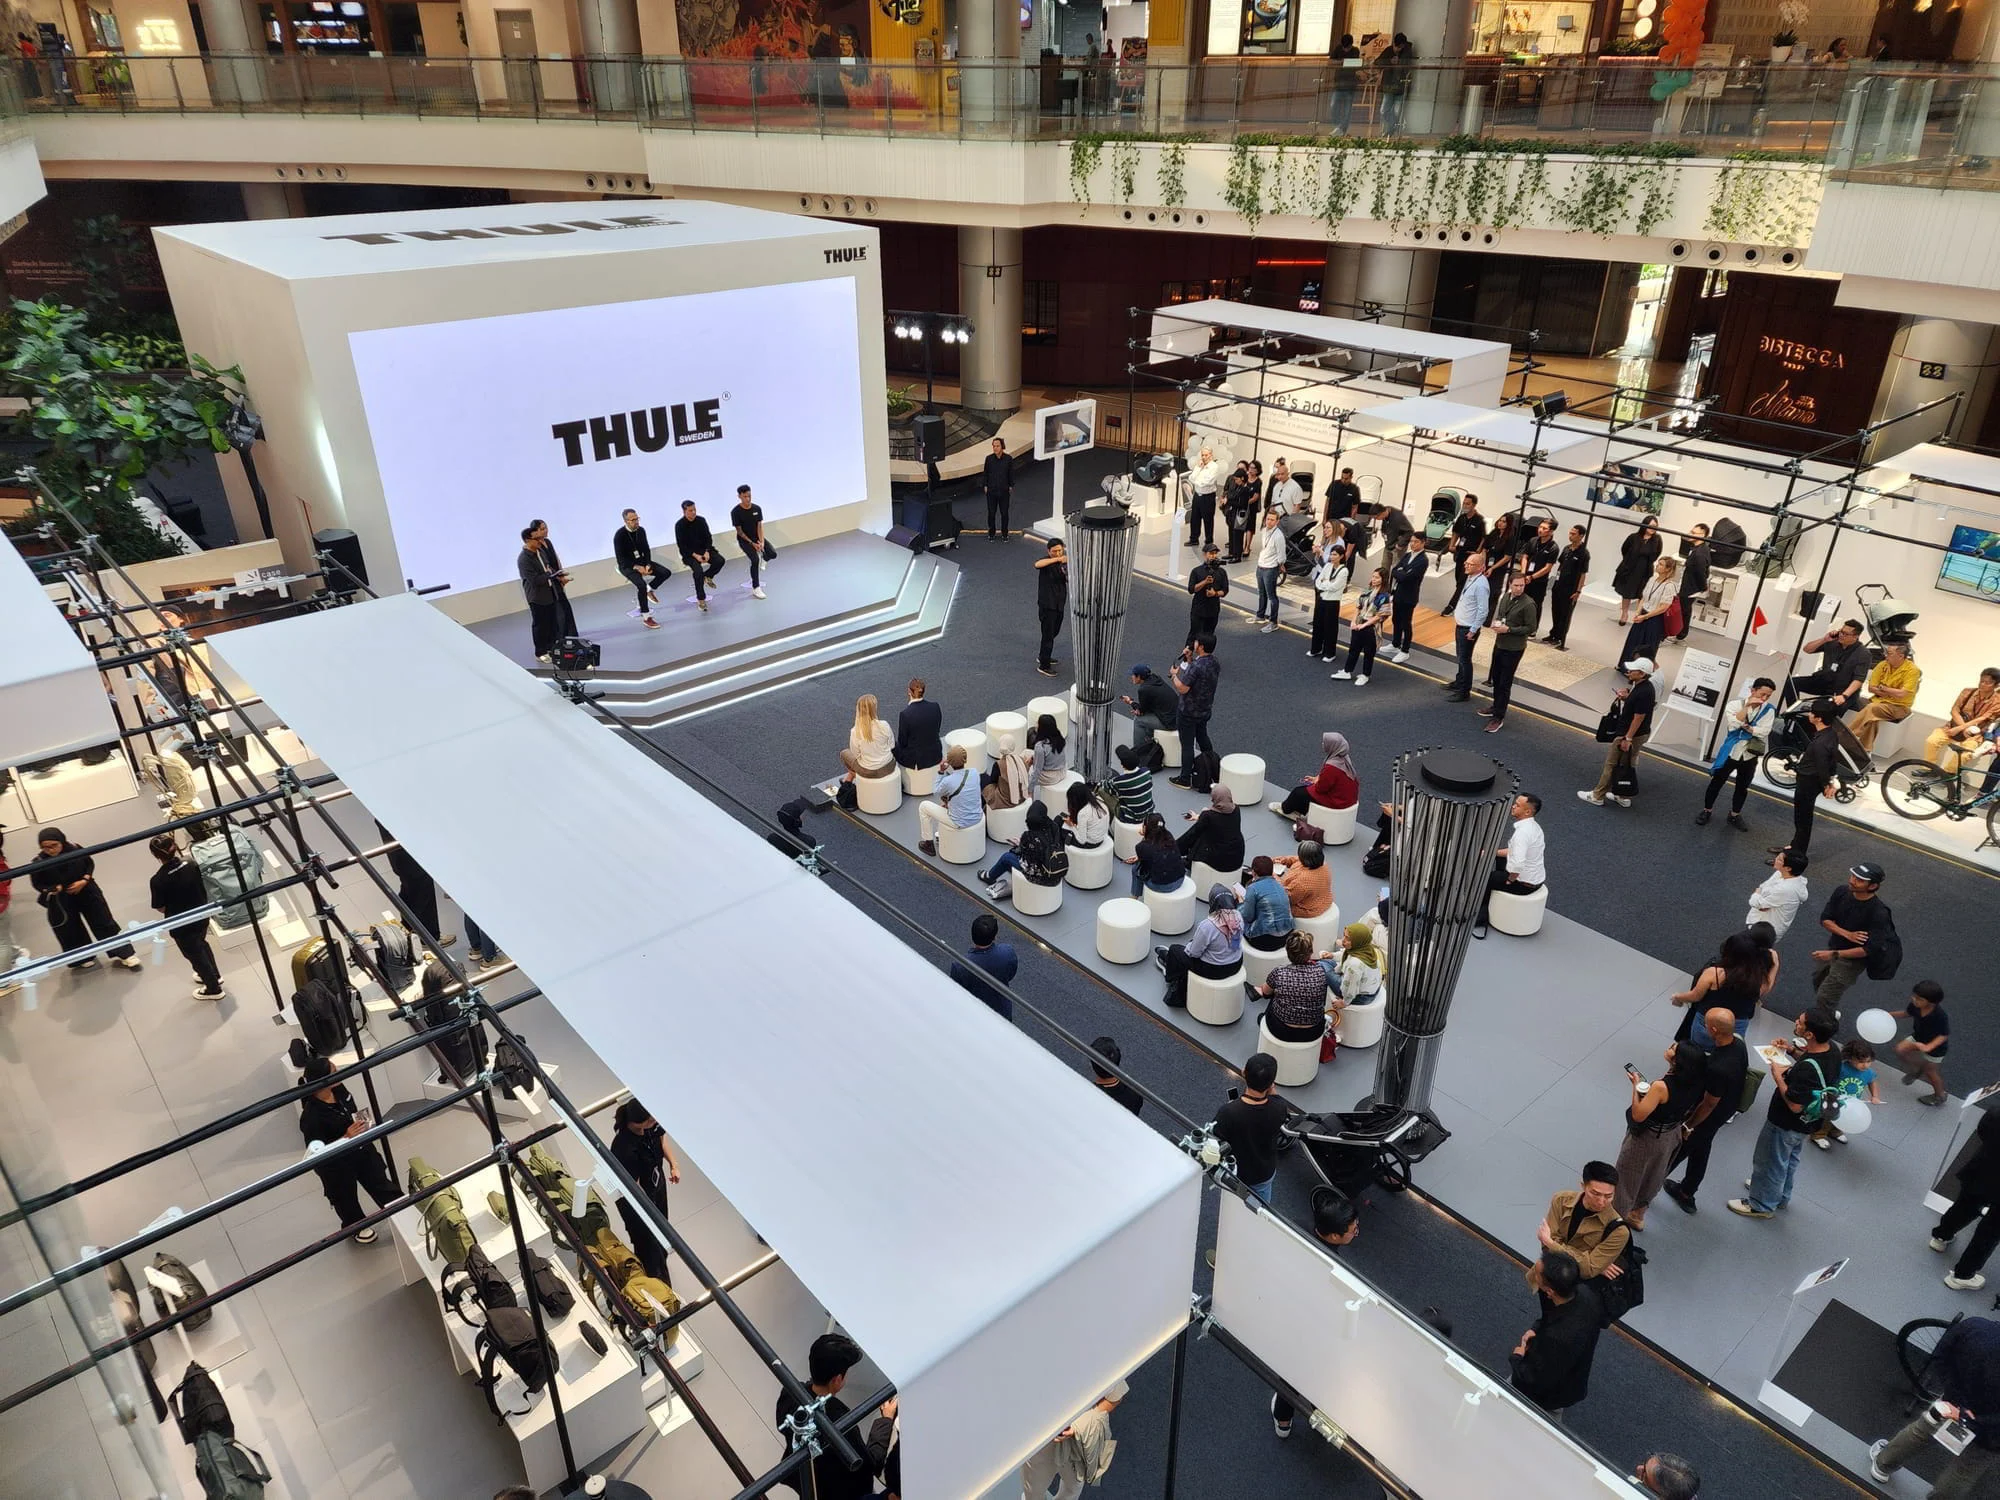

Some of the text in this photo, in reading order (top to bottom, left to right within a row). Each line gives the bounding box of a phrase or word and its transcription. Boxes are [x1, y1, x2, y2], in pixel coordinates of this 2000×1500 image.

[320, 215, 685, 245] THULE
[823, 246, 867, 264] THULE
[552, 398, 722, 467] THULE
[678, 430, 716, 444] SWEDEN
